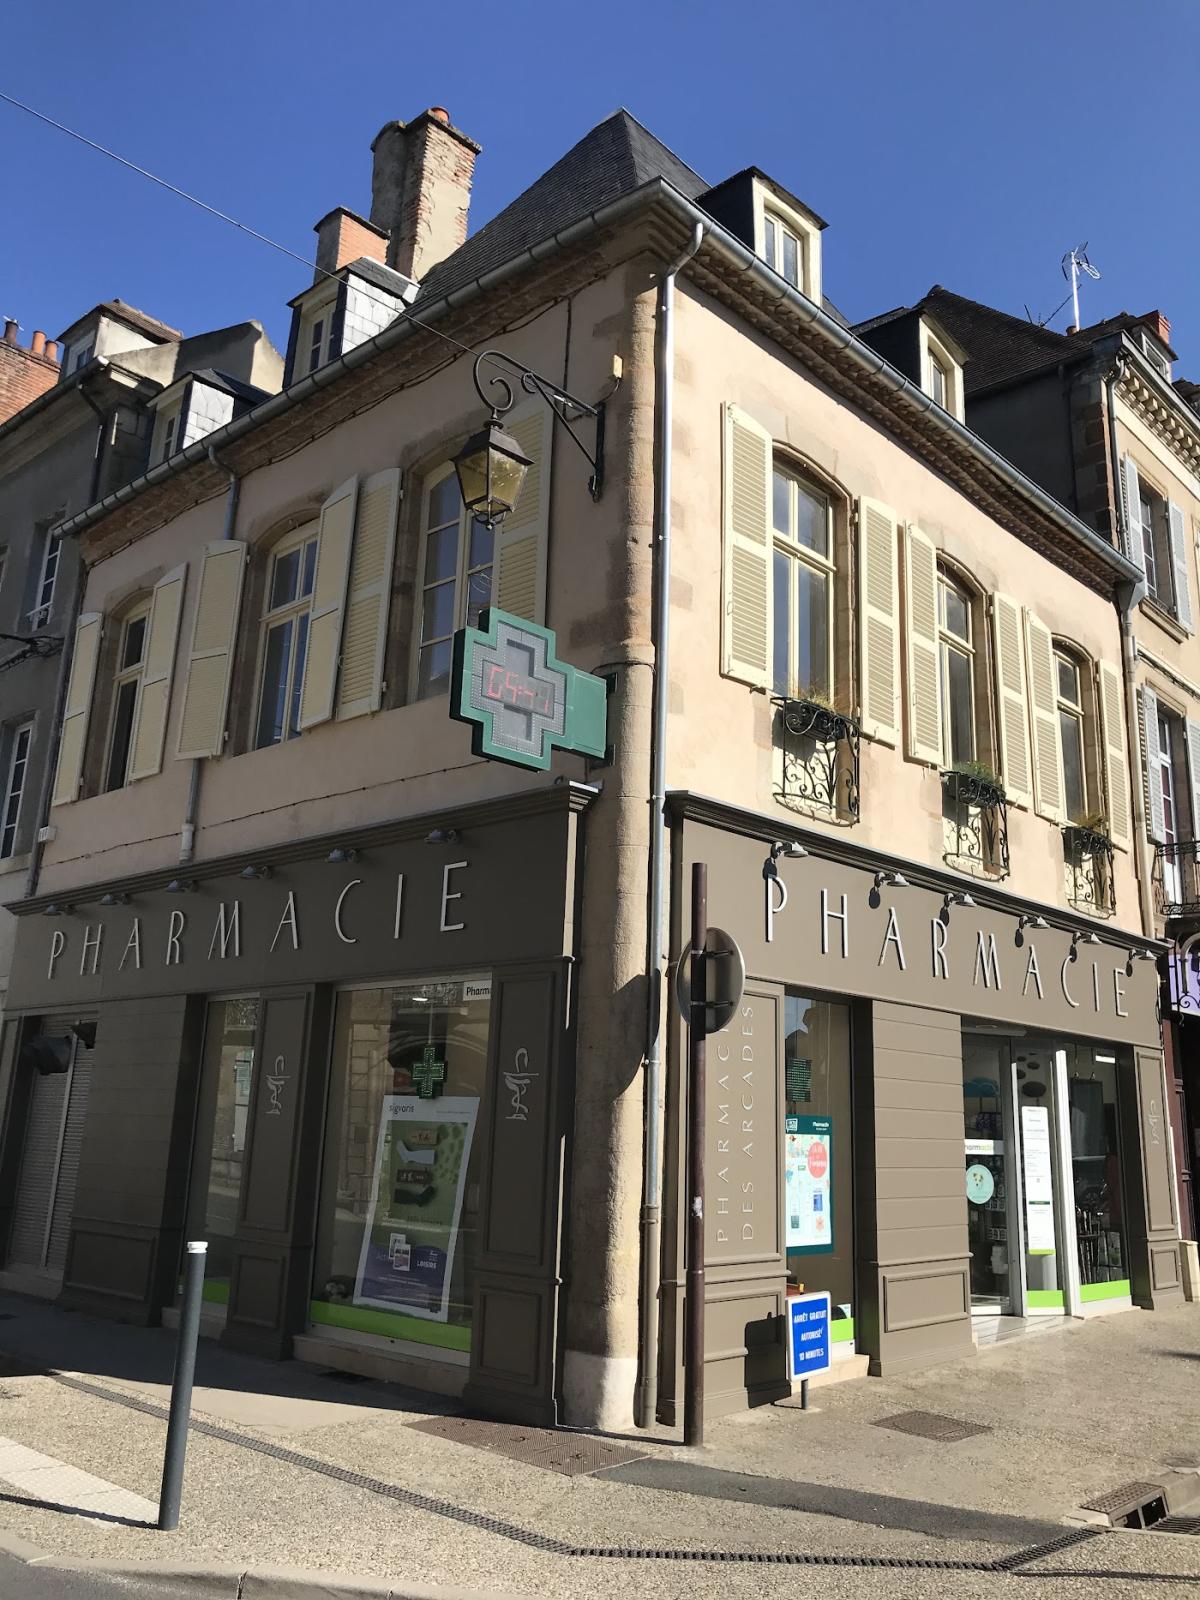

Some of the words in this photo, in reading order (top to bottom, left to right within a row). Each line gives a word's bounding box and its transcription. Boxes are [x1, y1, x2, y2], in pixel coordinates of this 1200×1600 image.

[48, 861, 469, 980] PHARMACIE
[765, 875, 1129, 1017] PHARMACIE
[717, 1028, 730, 1242] PHARMACI
[741, 1007, 754, 1158] ARCADES
[742, 1181, 754, 1241] DES
[794, 1312, 808, 1323] ARRÊT
[809, 1310, 827, 1320] GRATUIT
[799, 1352, 804, 1361] 10
[805, 1348, 824, 1359] MINUTES
